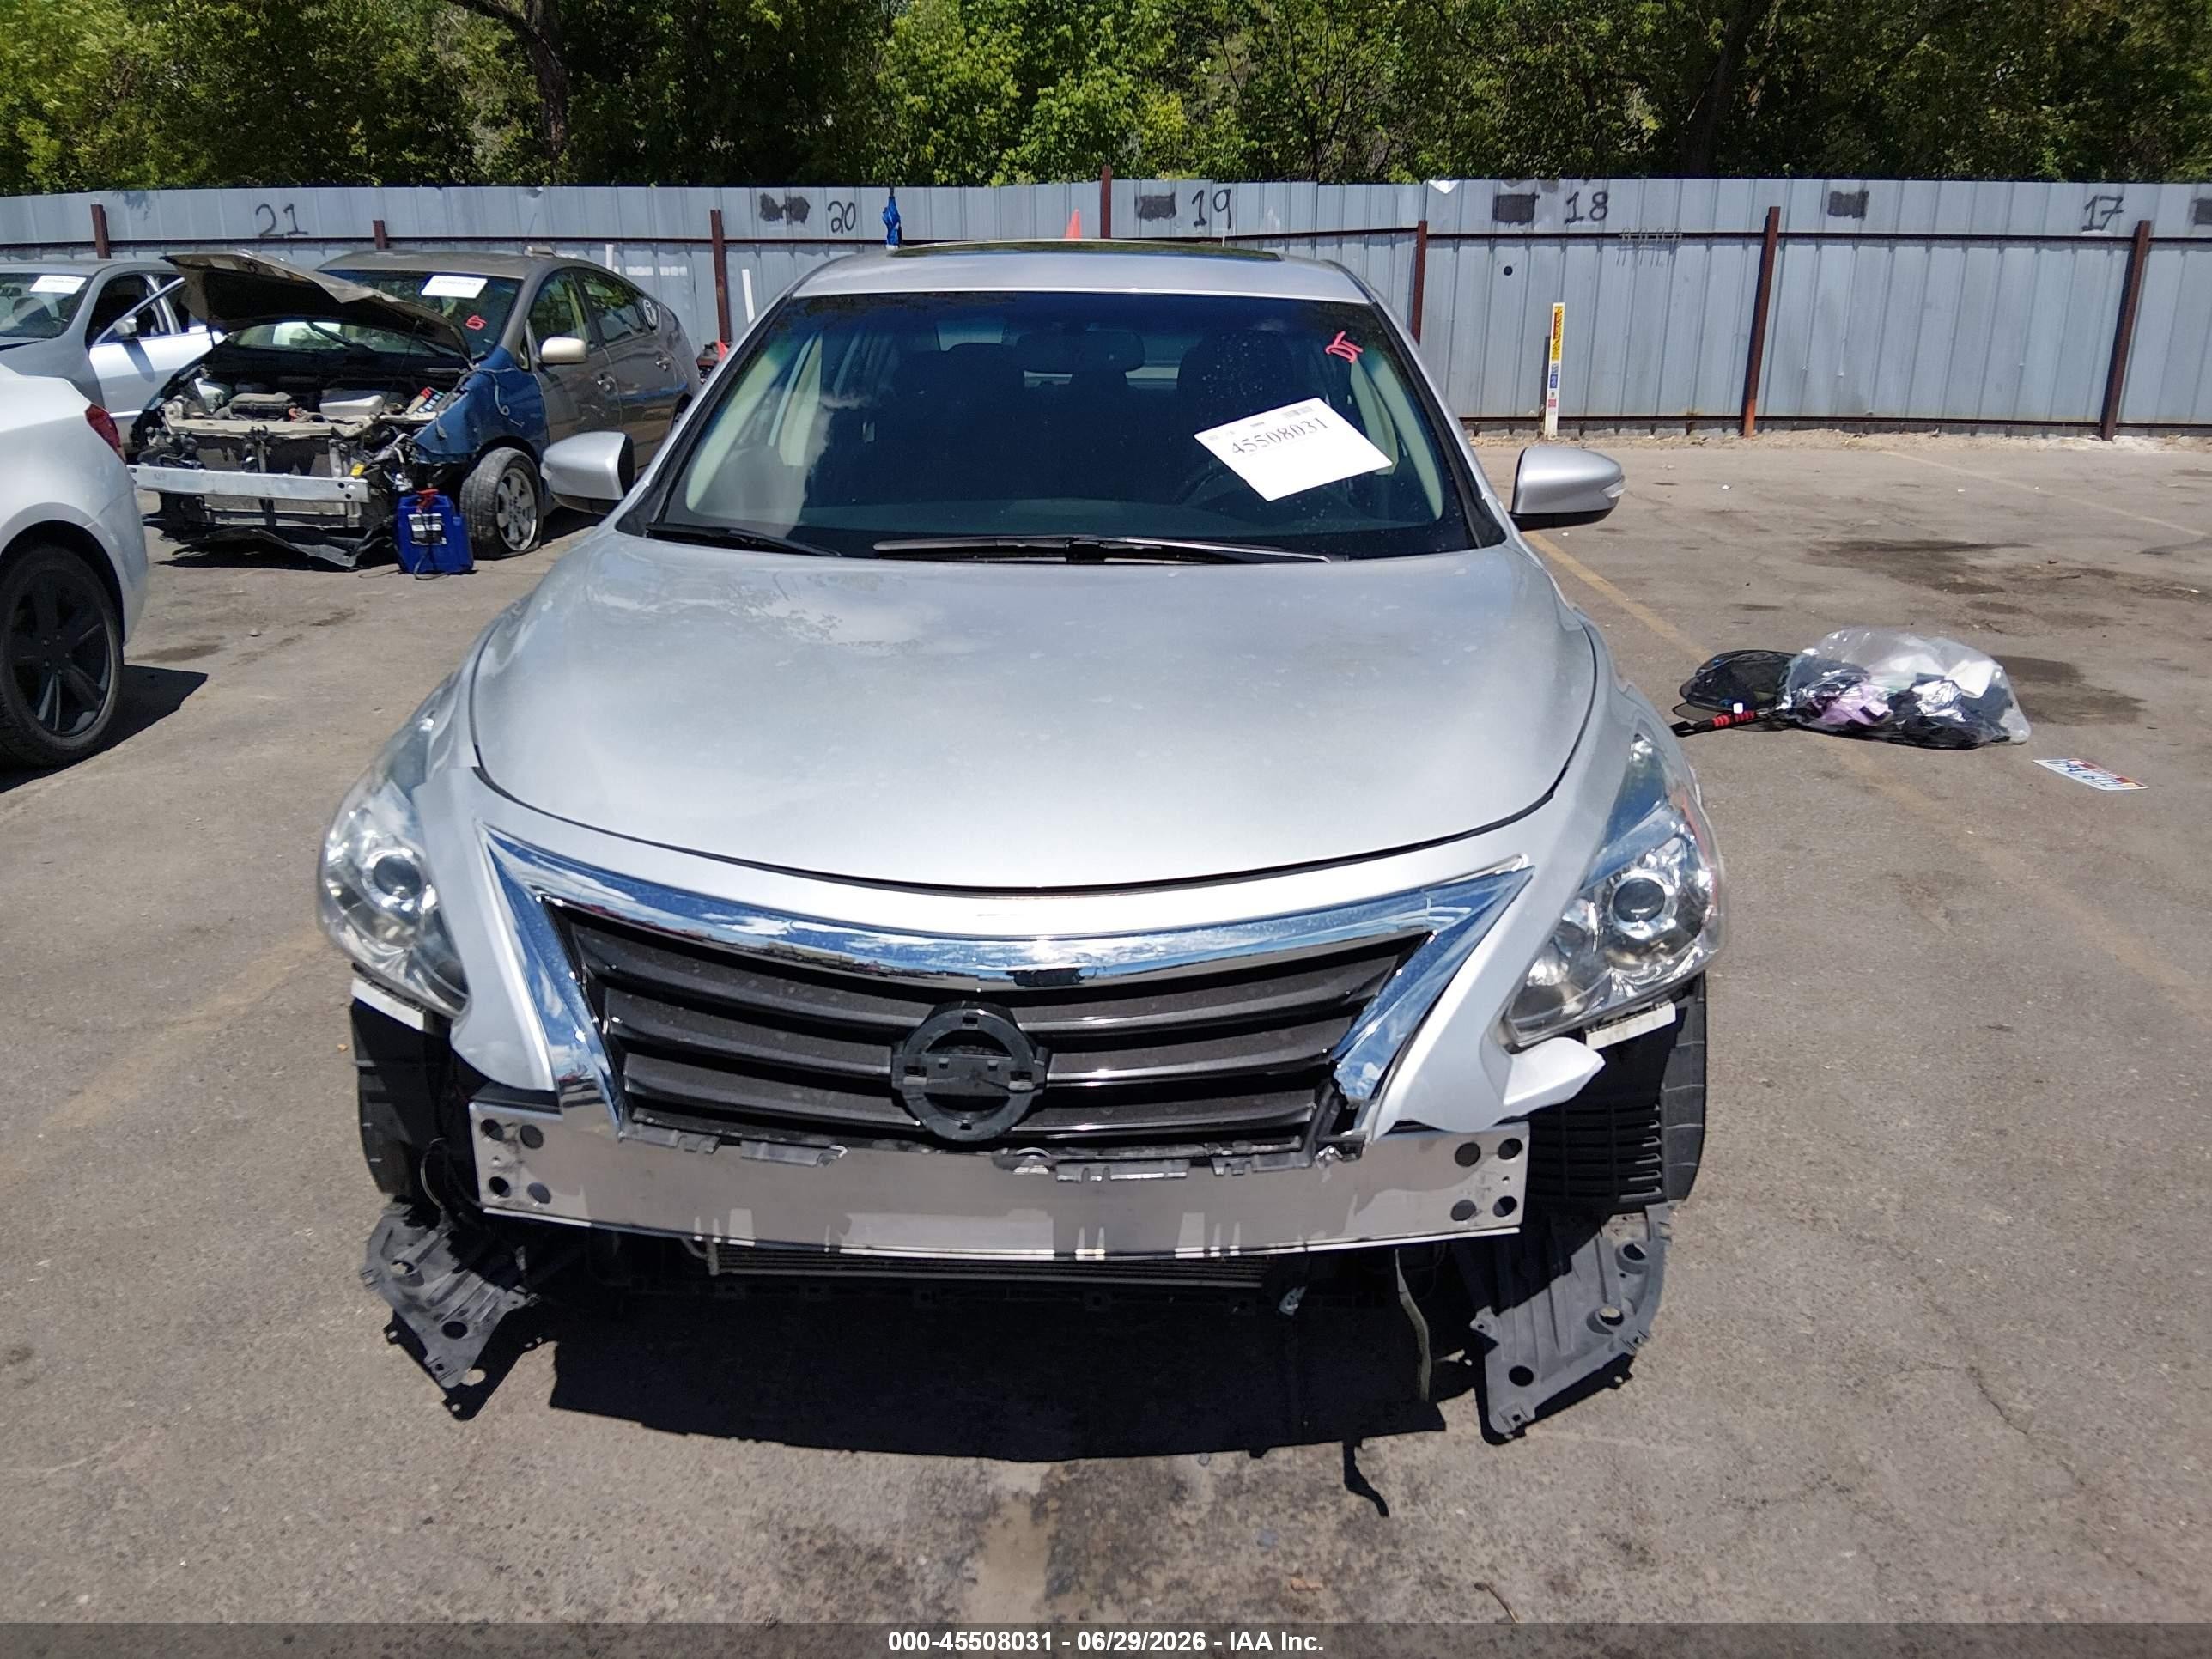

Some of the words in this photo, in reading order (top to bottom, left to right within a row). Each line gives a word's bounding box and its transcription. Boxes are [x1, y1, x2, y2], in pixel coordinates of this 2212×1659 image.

[255, 203, 309, 238] 21
[827, 200, 857, 234] 20
[1191, 189, 1232, 230] 19
[1564, 191, 1609, 224] 18
[2081, 195, 2124, 231] 17
[1231, 417, 1329, 455] 45508031
